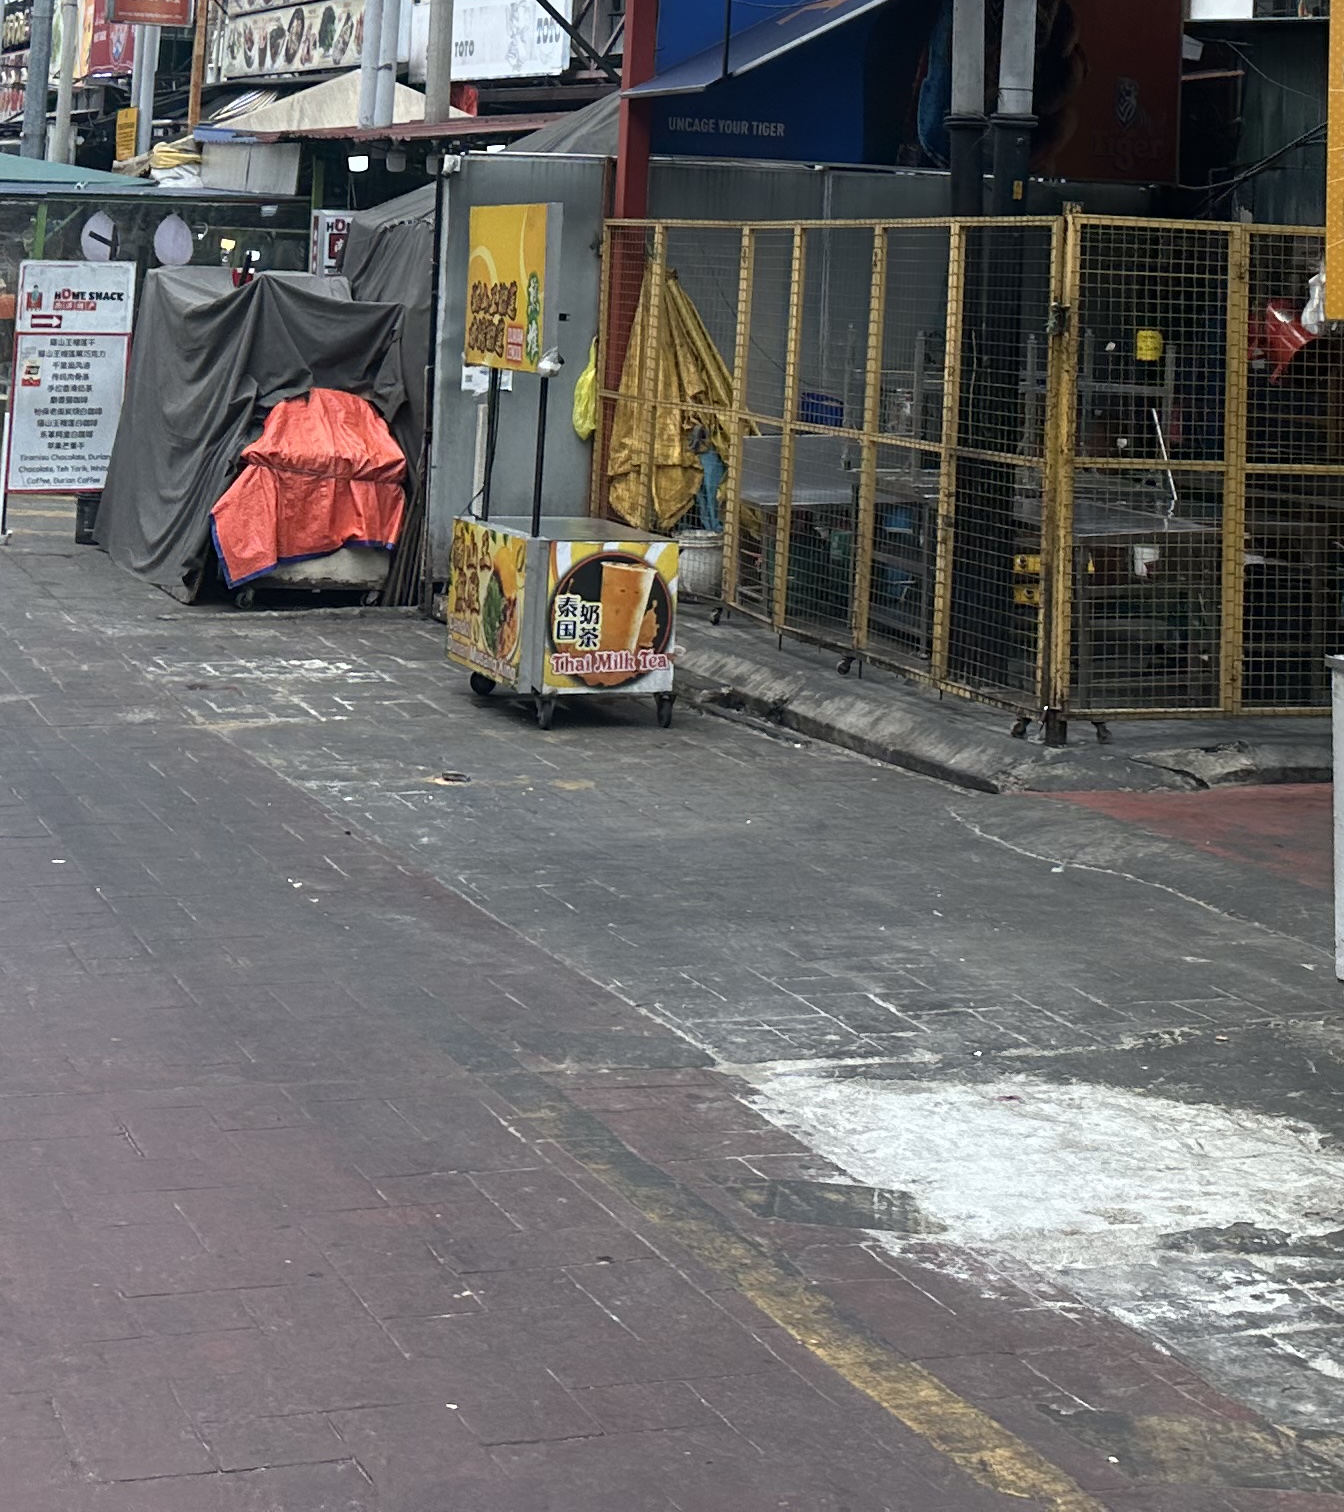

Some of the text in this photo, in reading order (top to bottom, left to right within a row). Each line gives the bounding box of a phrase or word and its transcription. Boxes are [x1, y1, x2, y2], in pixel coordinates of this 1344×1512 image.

[536, 17, 561, 45] TOTO
[454, 40, 475, 58] TOTO
[668, 116, 786, 137] UNCAGE YOUR TIGER
[54, 288, 125, 301] HOME SNACK
[558, 596, 577, 641] 泰国
[578, 603, 600, 649] 奶茶
[553, 649, 669, 673] Thai Milk Tea
